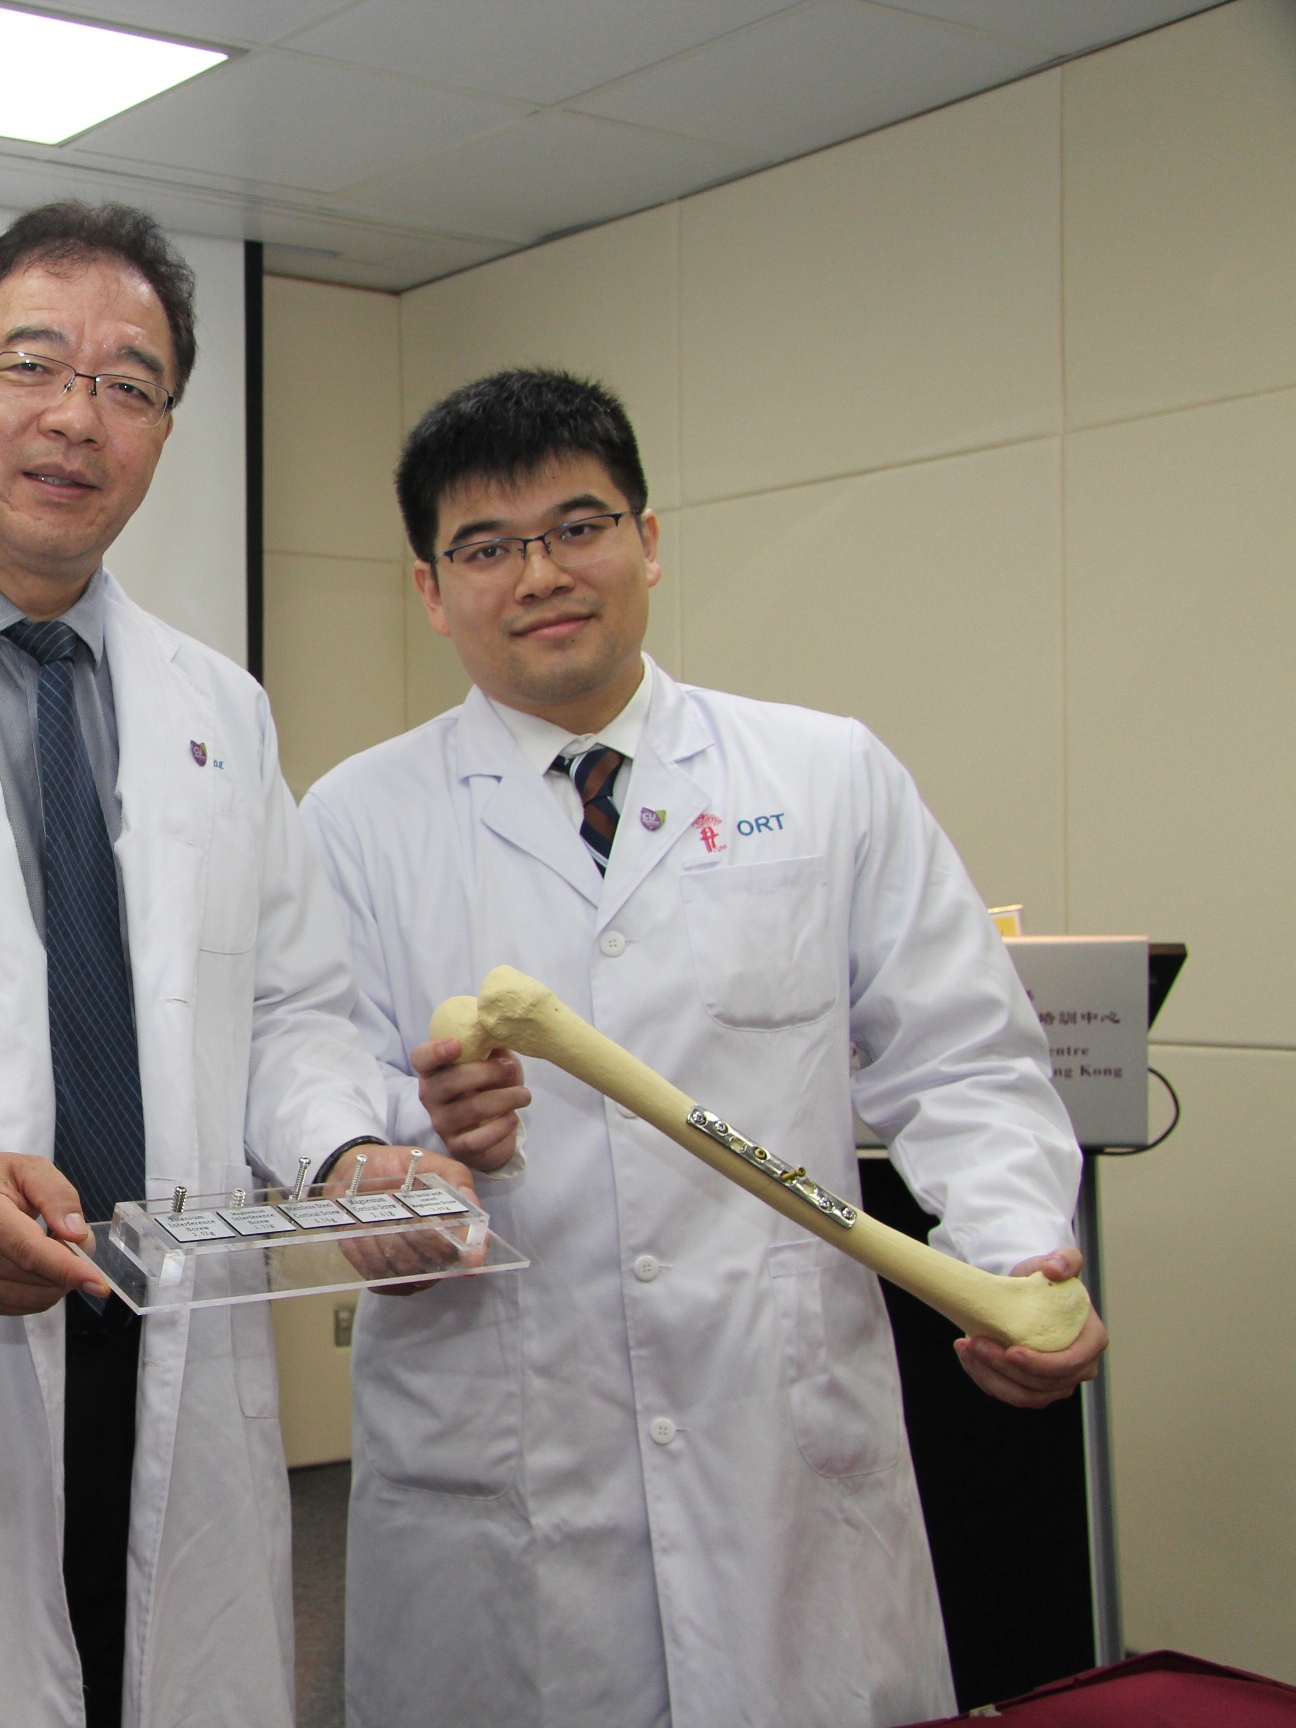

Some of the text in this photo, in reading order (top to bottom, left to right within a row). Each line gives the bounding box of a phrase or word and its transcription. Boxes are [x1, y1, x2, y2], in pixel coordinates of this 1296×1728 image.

[737, 813, 784, 836] ORT
[1080, 1065, 1123, 1079] Kong
[348, 1196, 387, 1206] Magnesium
[378, 1202, 397, 1210] Screw
[284, 1202, 334, 1212] Stainless Steel
[293, 1208, 340, 1219] Cortical Screw
[168, 1220, 217, 1228] Interference
